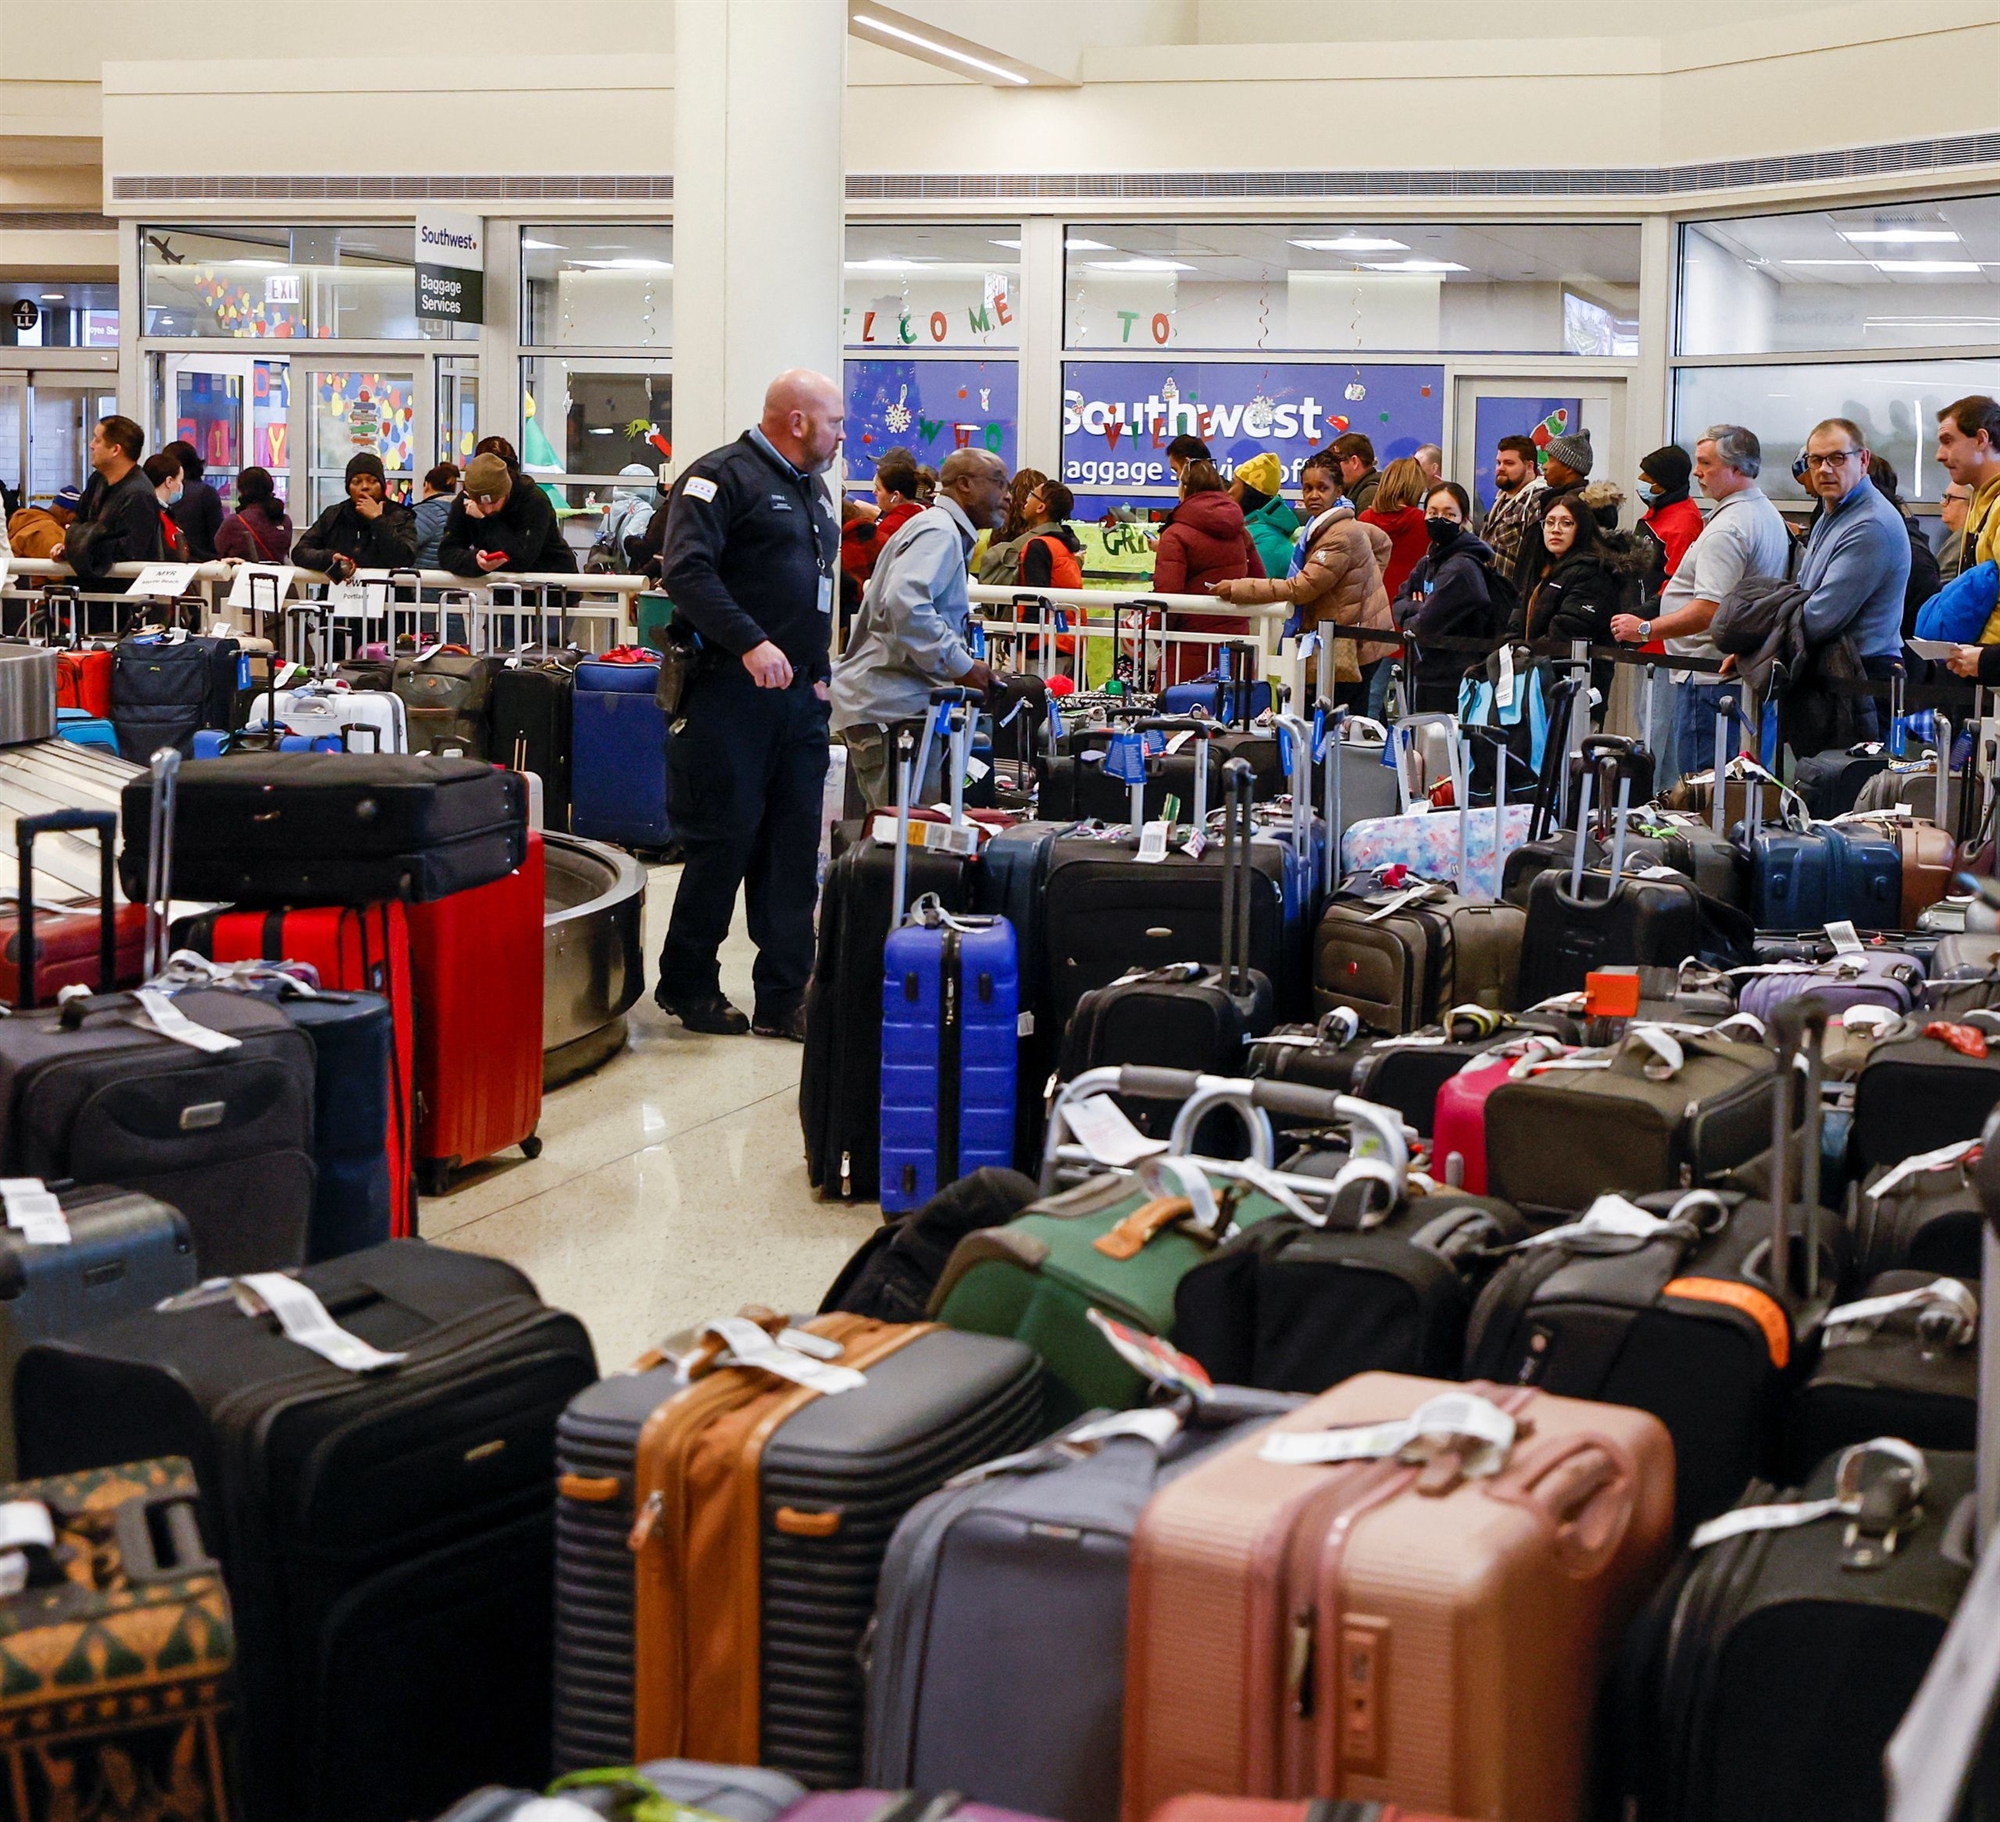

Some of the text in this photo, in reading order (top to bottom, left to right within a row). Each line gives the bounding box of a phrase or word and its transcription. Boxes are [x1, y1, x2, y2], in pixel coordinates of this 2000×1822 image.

[421, 225, 473, 250] Southwest
[271, 279, 300, 299] EXIT
[420, 273, 462, 297] Baggage
[20, 301, 30, 314] 4
[421, 294, 462, 314] Services
[17, 316, 33, 327] LL
[1116, 310, 1171, 345] TO
[1064, 389, 1323, 440] Southwest
[1063, 460, 1163, 486] aggage
[343, 592, 370, 600] Portlad
